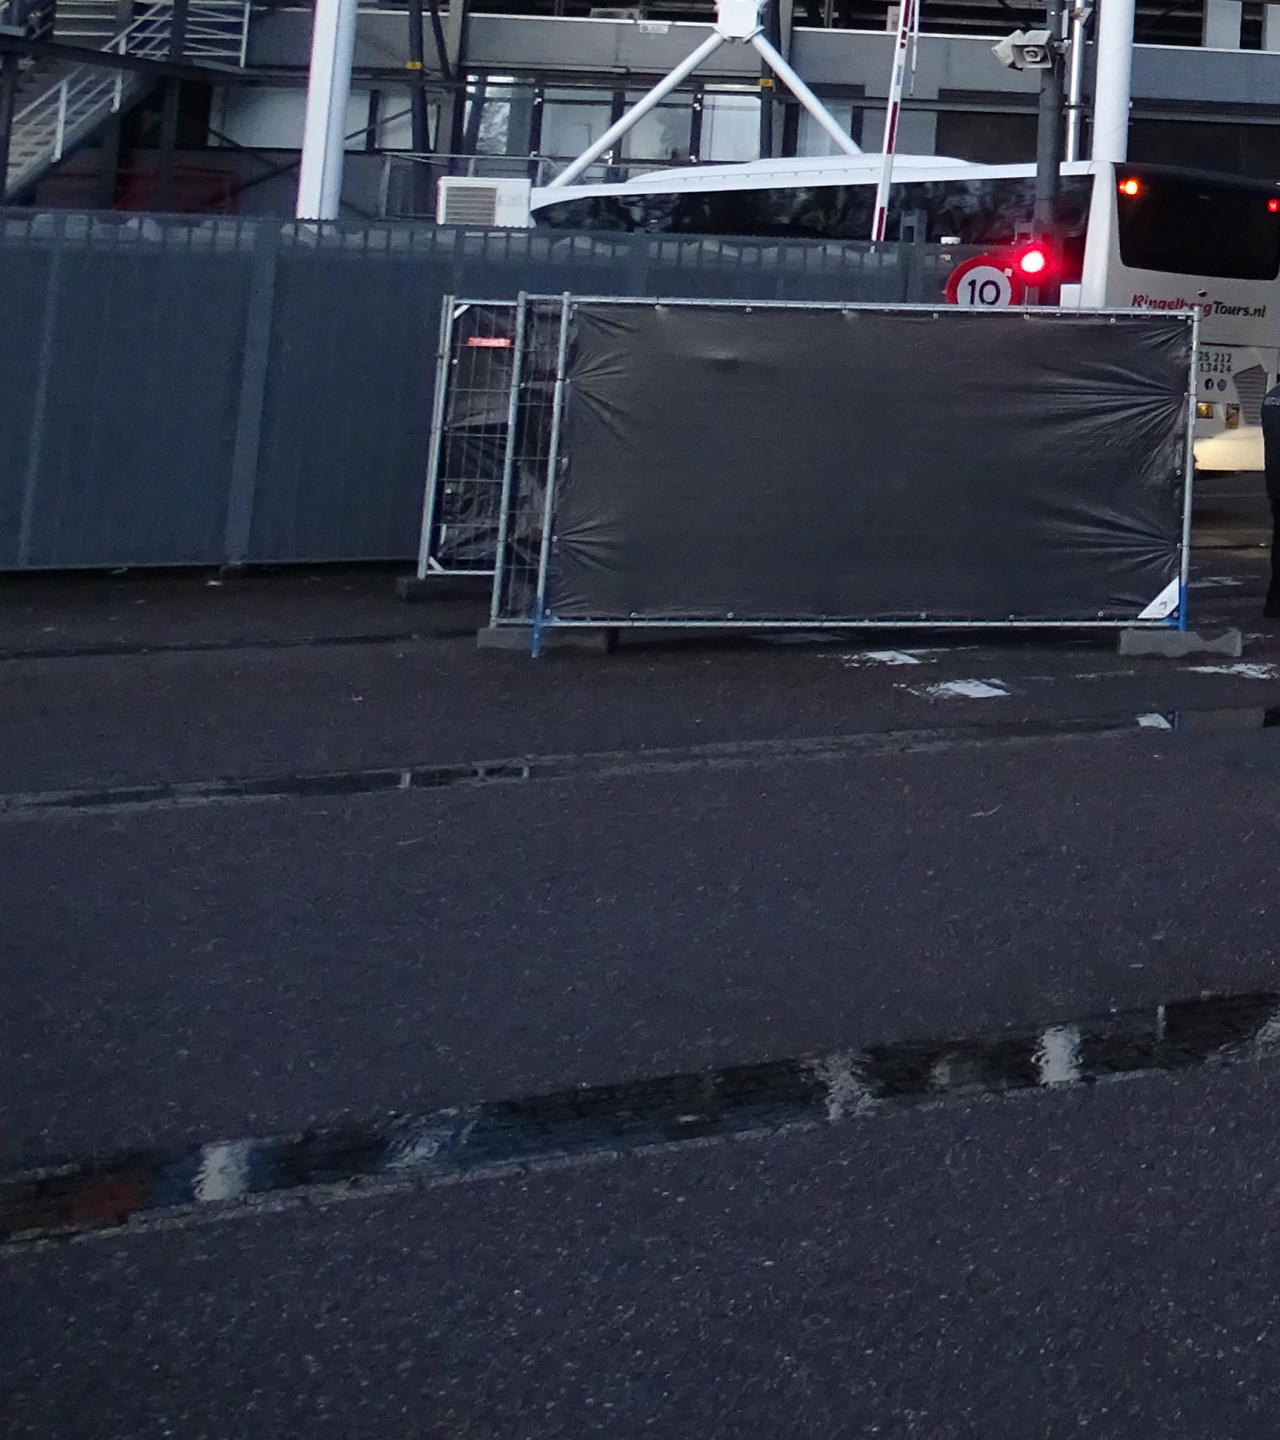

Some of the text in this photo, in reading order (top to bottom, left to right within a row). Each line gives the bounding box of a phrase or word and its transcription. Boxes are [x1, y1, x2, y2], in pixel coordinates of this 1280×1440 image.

[967, 279, 1001, 306] 10
[1131, 293, 1267, 319] RingelbgTours.nl
[1213, 352, 1233, 363] 212
